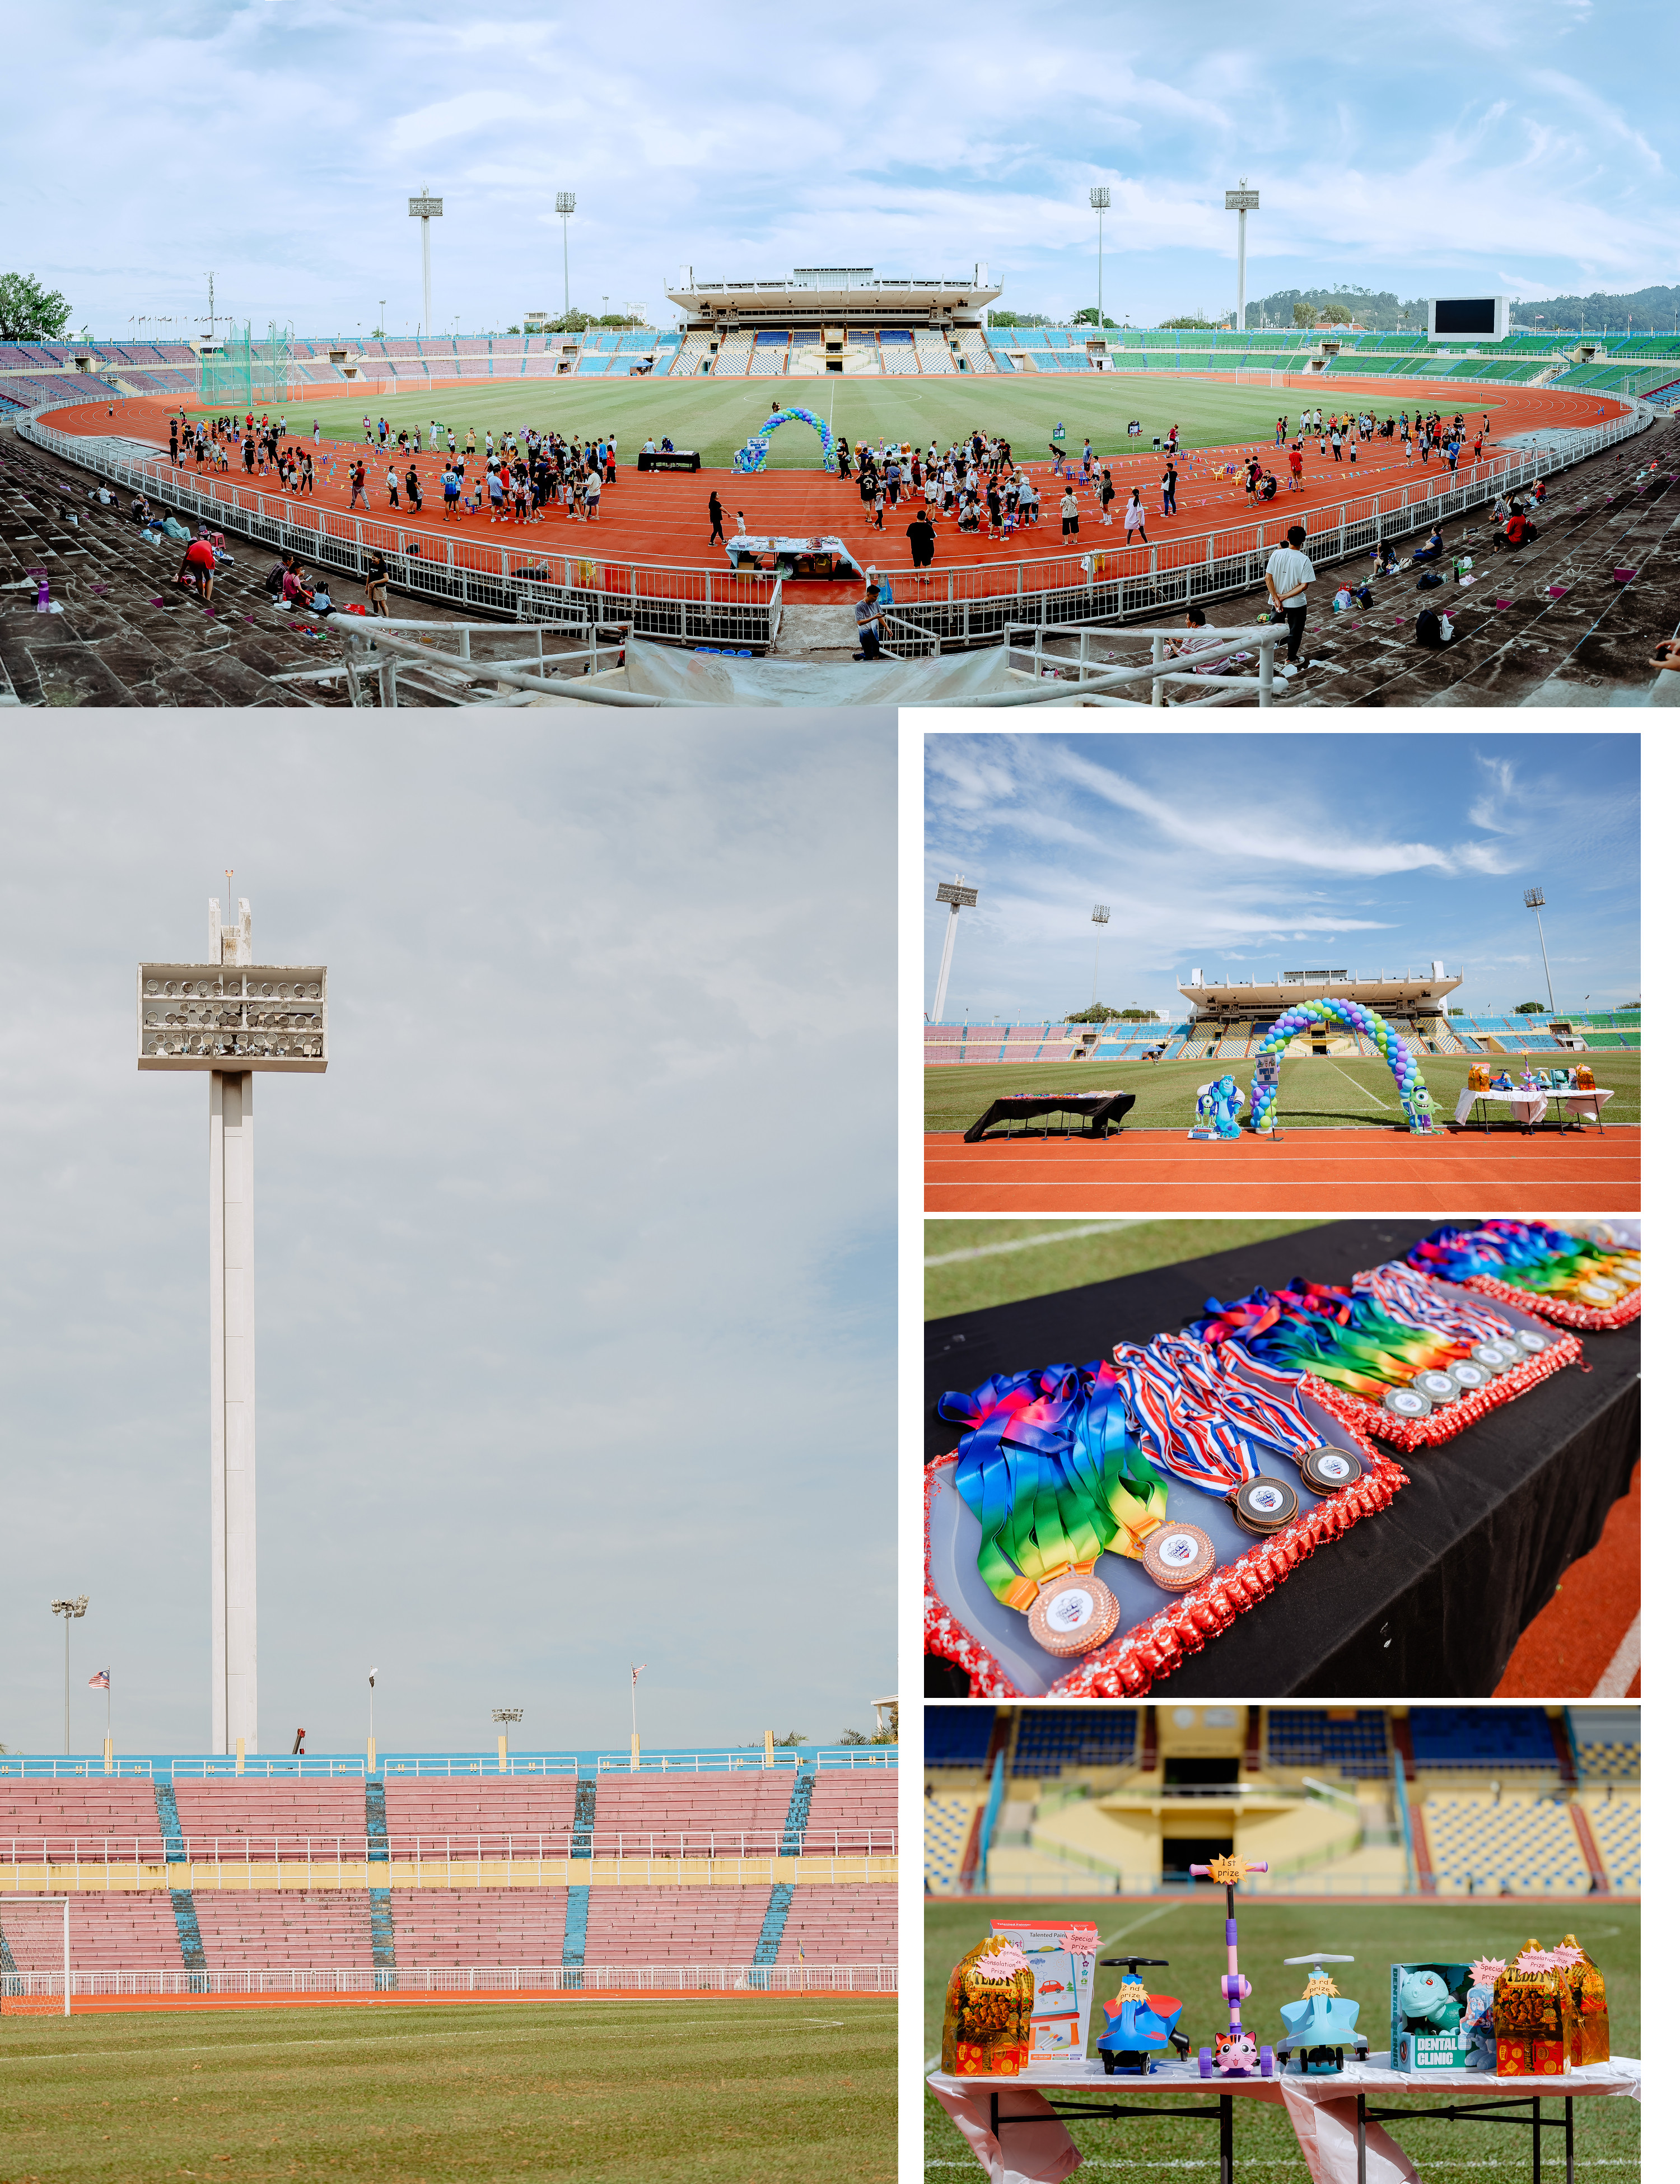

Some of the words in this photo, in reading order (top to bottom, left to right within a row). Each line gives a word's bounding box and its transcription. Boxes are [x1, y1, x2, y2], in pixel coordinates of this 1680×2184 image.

[1218, 1869, 1239, 1878] prize
[1071, 1934, 1093, 1943] Special
[1524, 1954, 1555, 1963] Consolation
[1554, 1949, 1579, 1960] Consolation
[984, 1959, 1015, 1967] Consolation
[1480, 1963, 1503, 1972] Special
[1417, 2038, 1457, 2051] DENTAL
[1417, 2052, 1453, 2065] CLINIC
